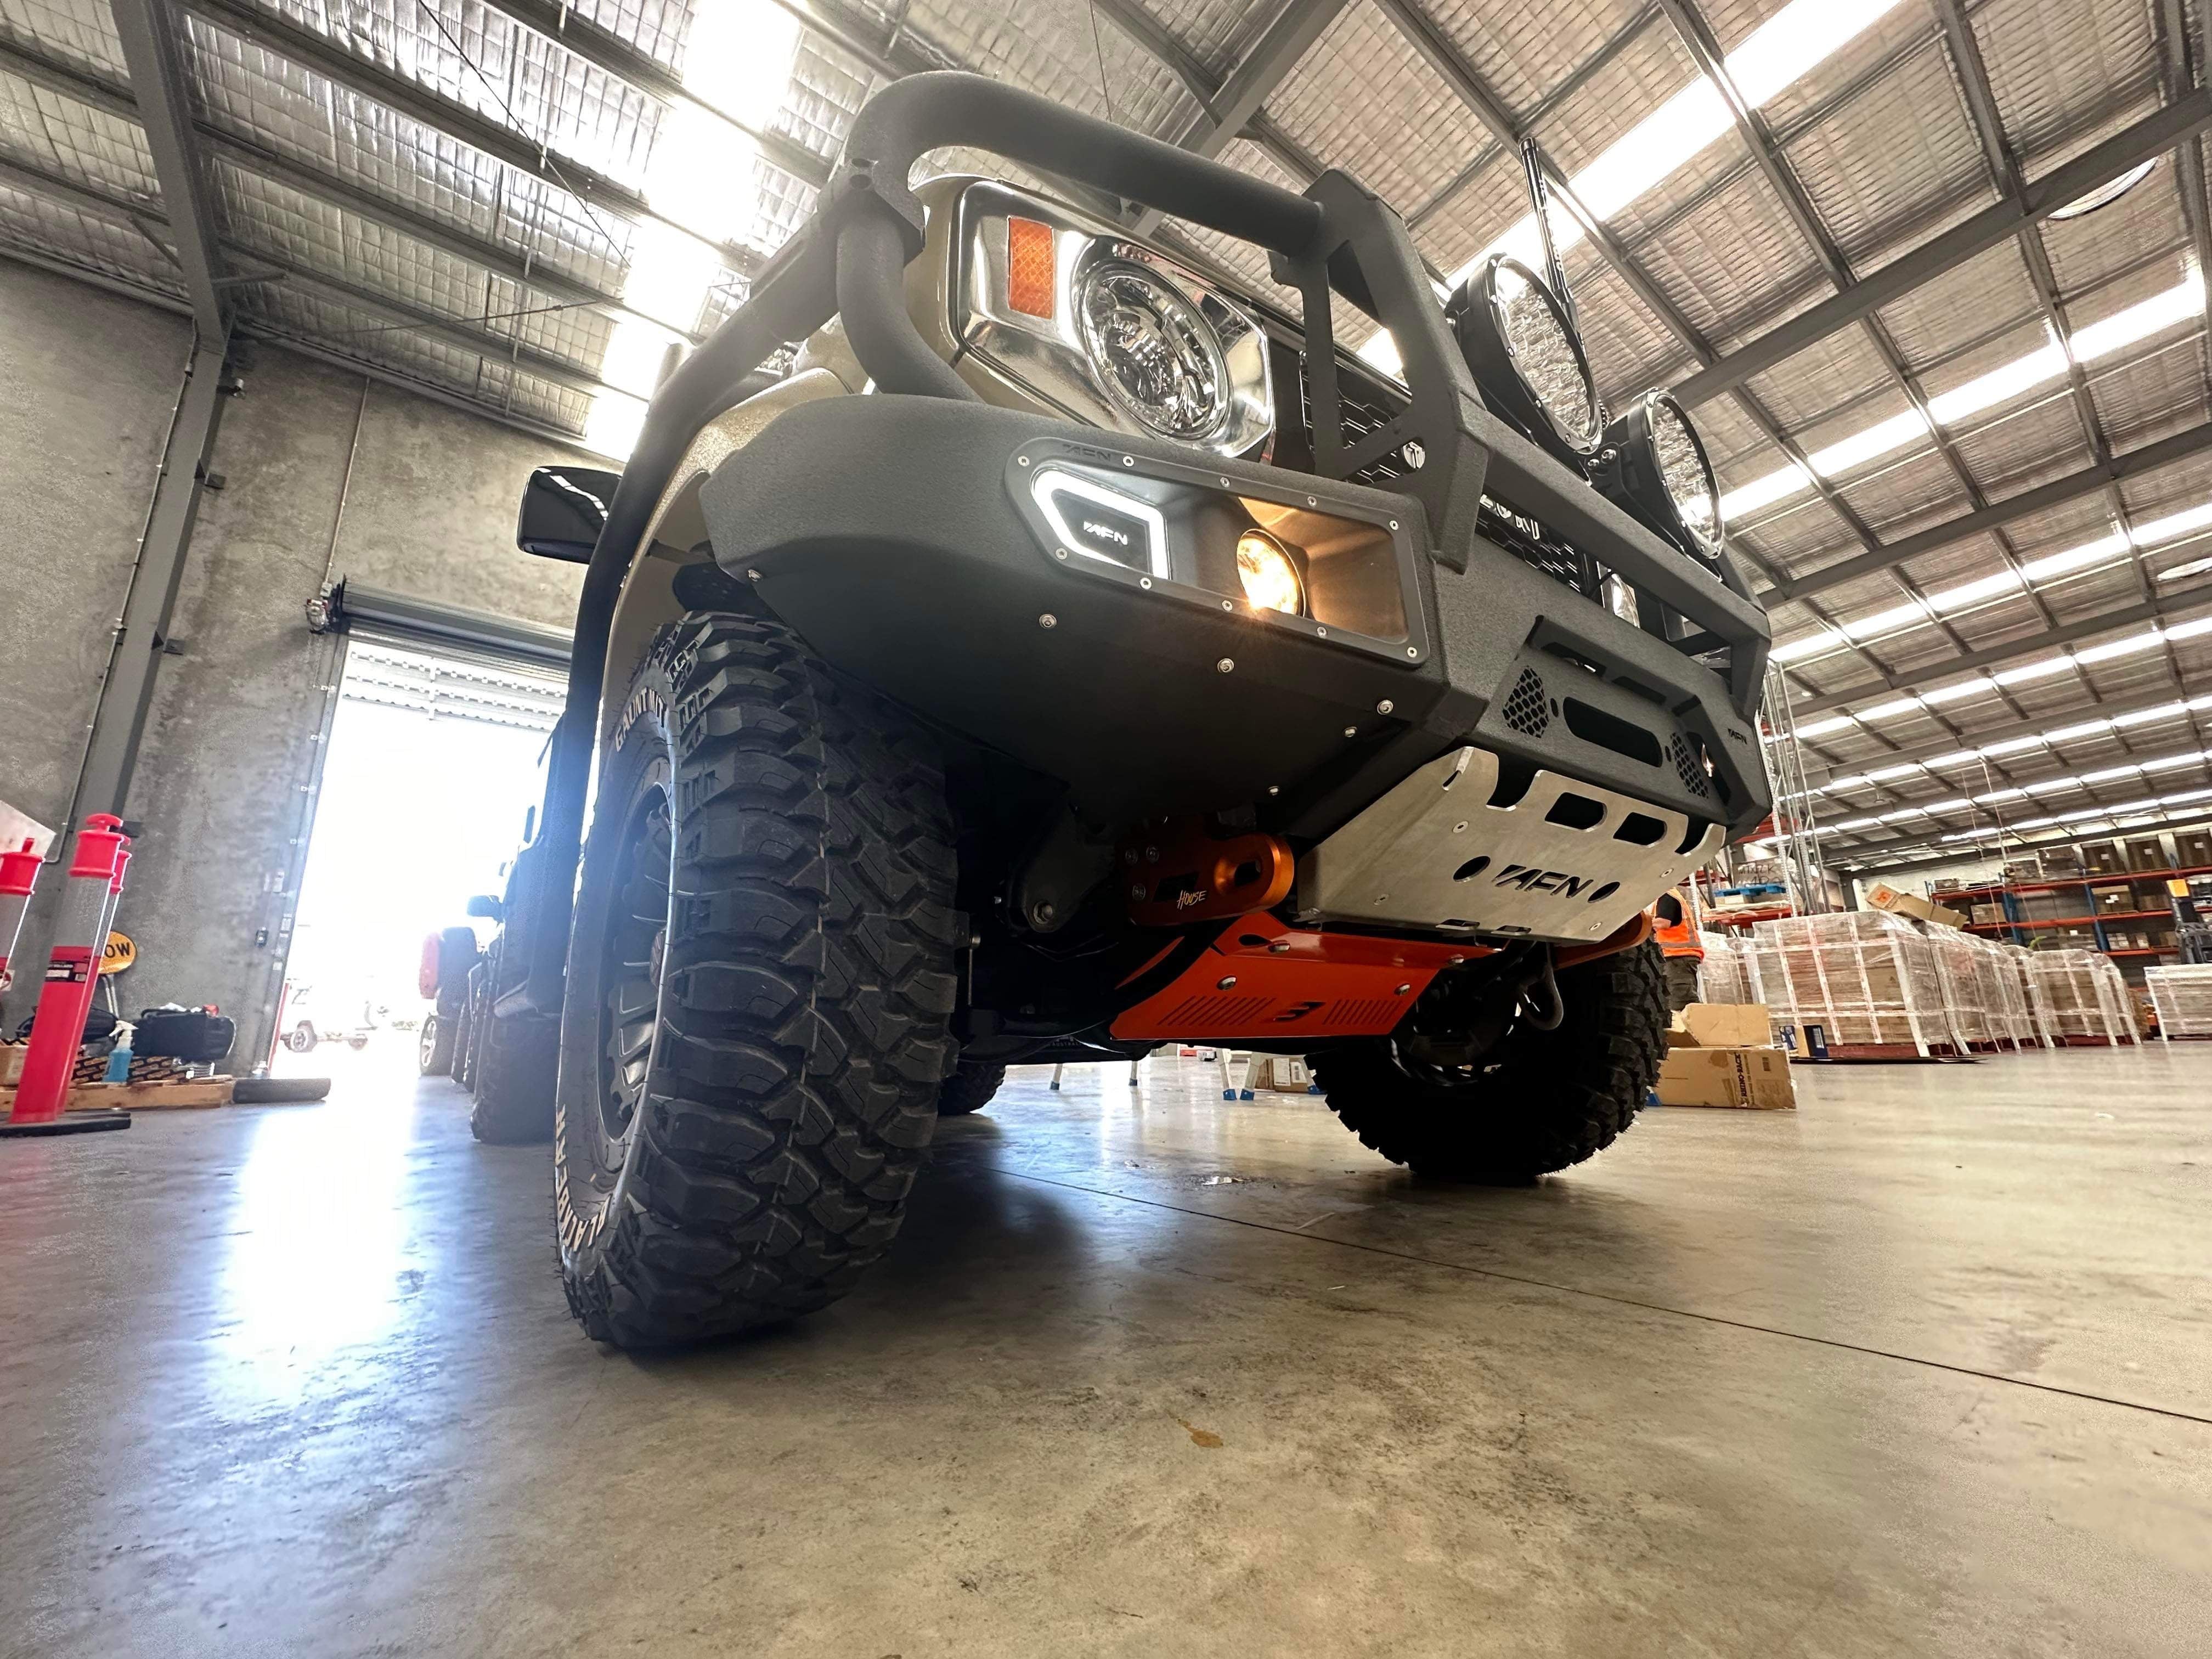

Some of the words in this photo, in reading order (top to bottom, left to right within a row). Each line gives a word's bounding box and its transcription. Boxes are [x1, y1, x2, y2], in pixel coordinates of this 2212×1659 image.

[1084, 521, 1128, 545] AFN
[615, 687, 648, 752] GAUNT
[1492, 865, 1594, 898] AFN
[1177, 890, 1207, 910] HOUSE
[105, 943, 130, 958] OW
[1734, 1052, 1747, 1097] RHINO-RACK
